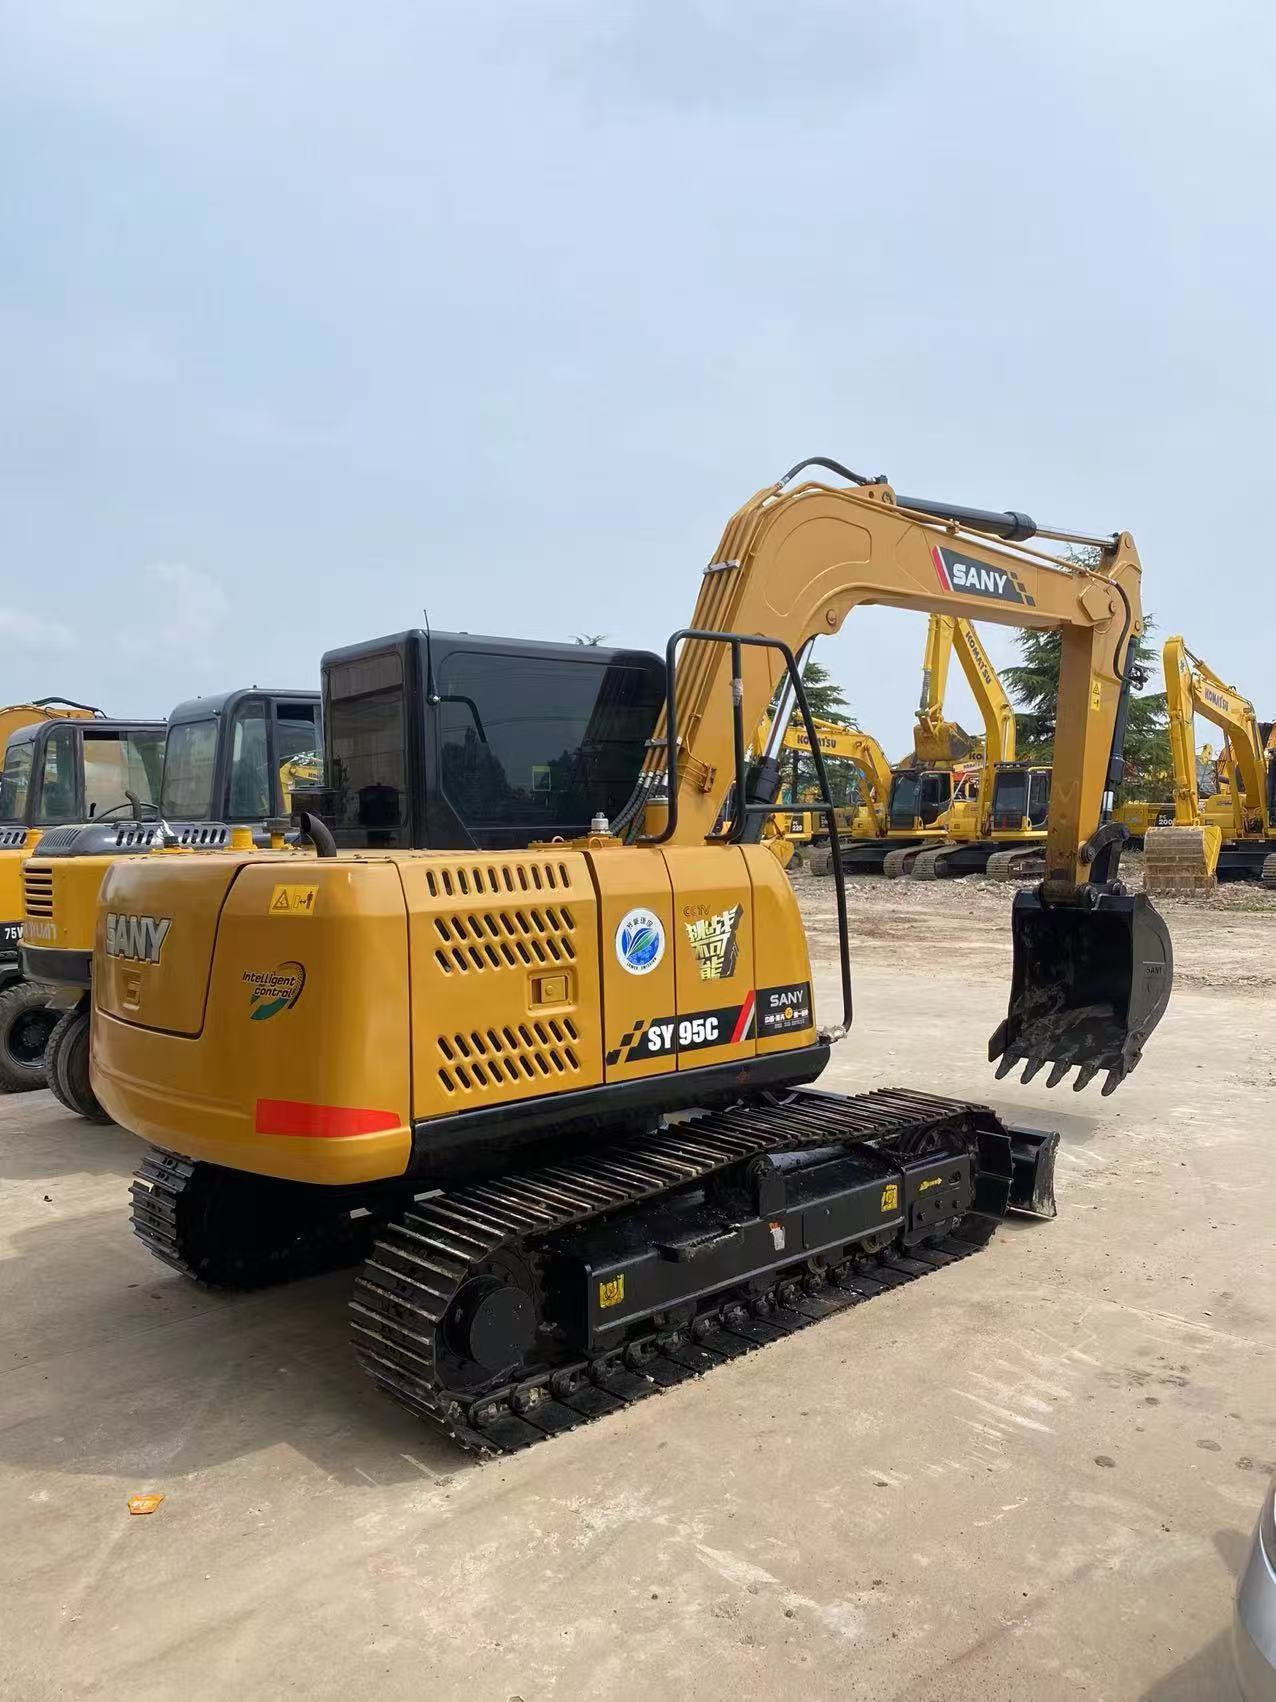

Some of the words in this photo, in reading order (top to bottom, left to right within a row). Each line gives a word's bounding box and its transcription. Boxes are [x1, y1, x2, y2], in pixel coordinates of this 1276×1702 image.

[952, 563, 1008, 594] SANY
[965, 630, 992, 685] KOMATSU
[106, 912, 172, 965] SANY
[691, 931, 731, 960] 不可
[242, 971, 296, 987] Intelligent
[700, 955, 724, 980] 能
[254, 987, 292, 998] control
[770, 990, 804, 1007] SANY
